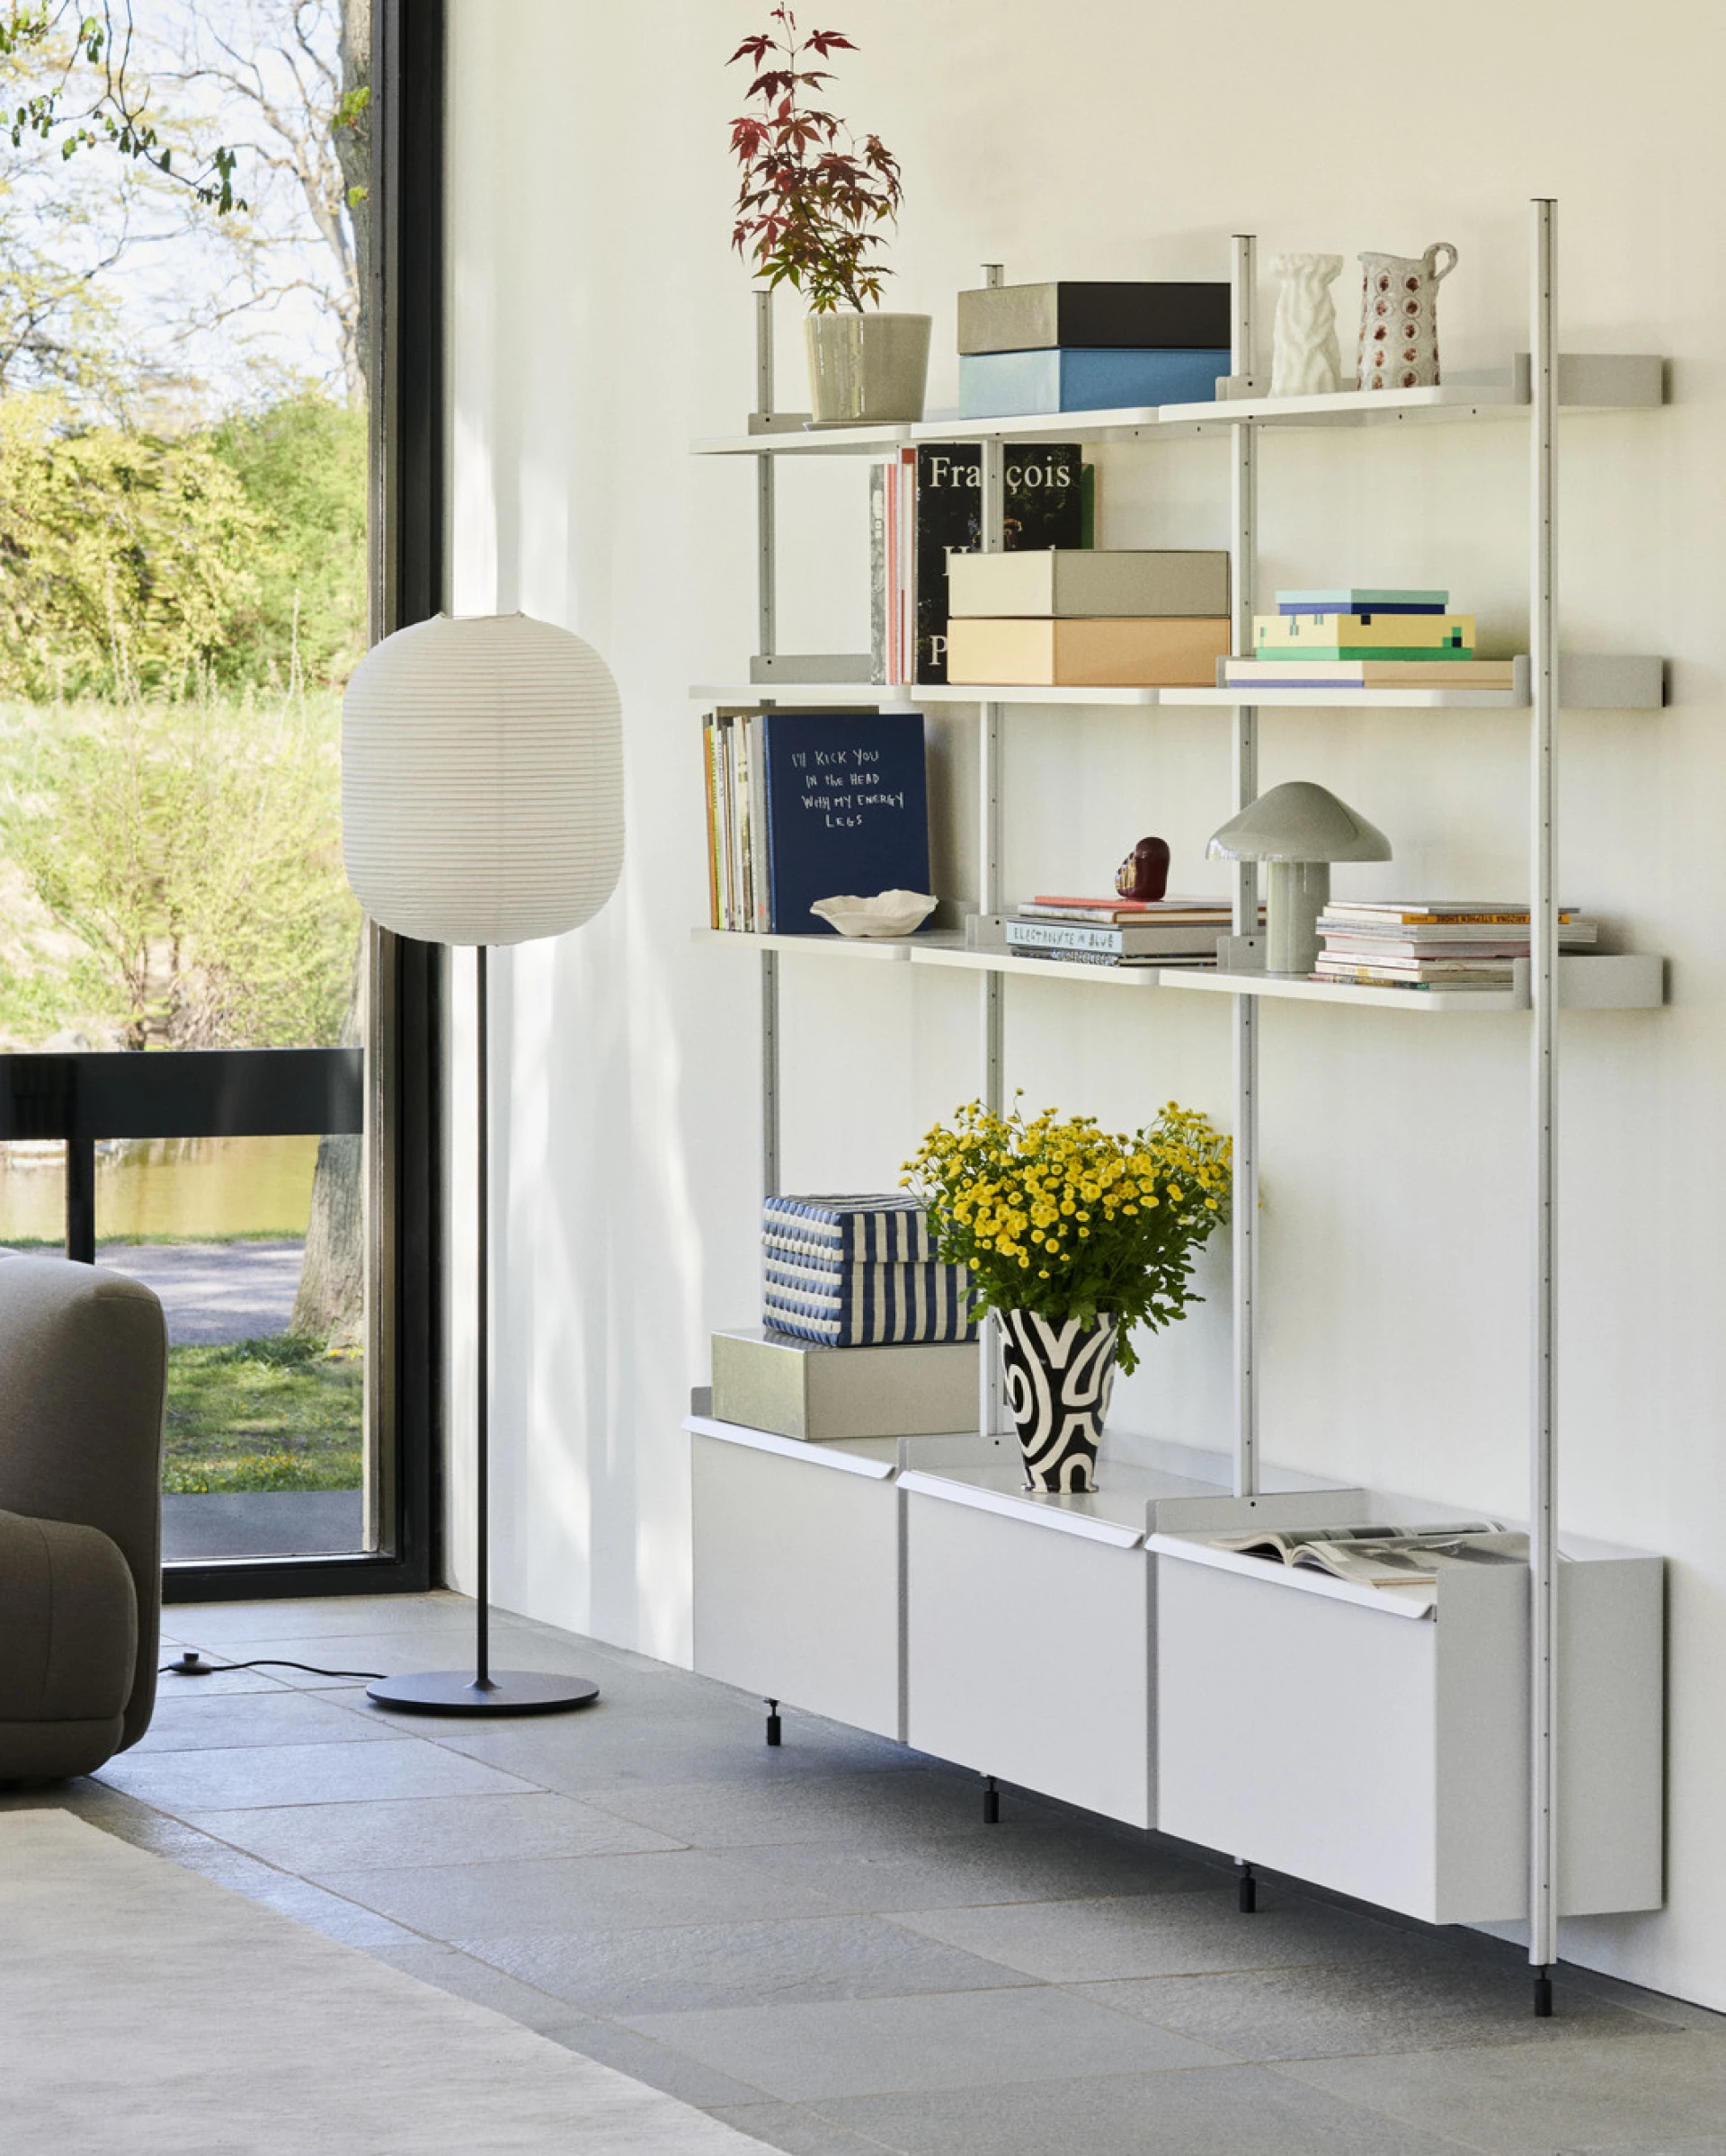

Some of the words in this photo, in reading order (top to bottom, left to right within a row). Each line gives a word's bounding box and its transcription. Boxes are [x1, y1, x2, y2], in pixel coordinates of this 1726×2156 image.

[929, 456, 1071, 495] Fraçois
[814, 750, 847, 765] KICK
[850, 773, 880, 785] HEAD
